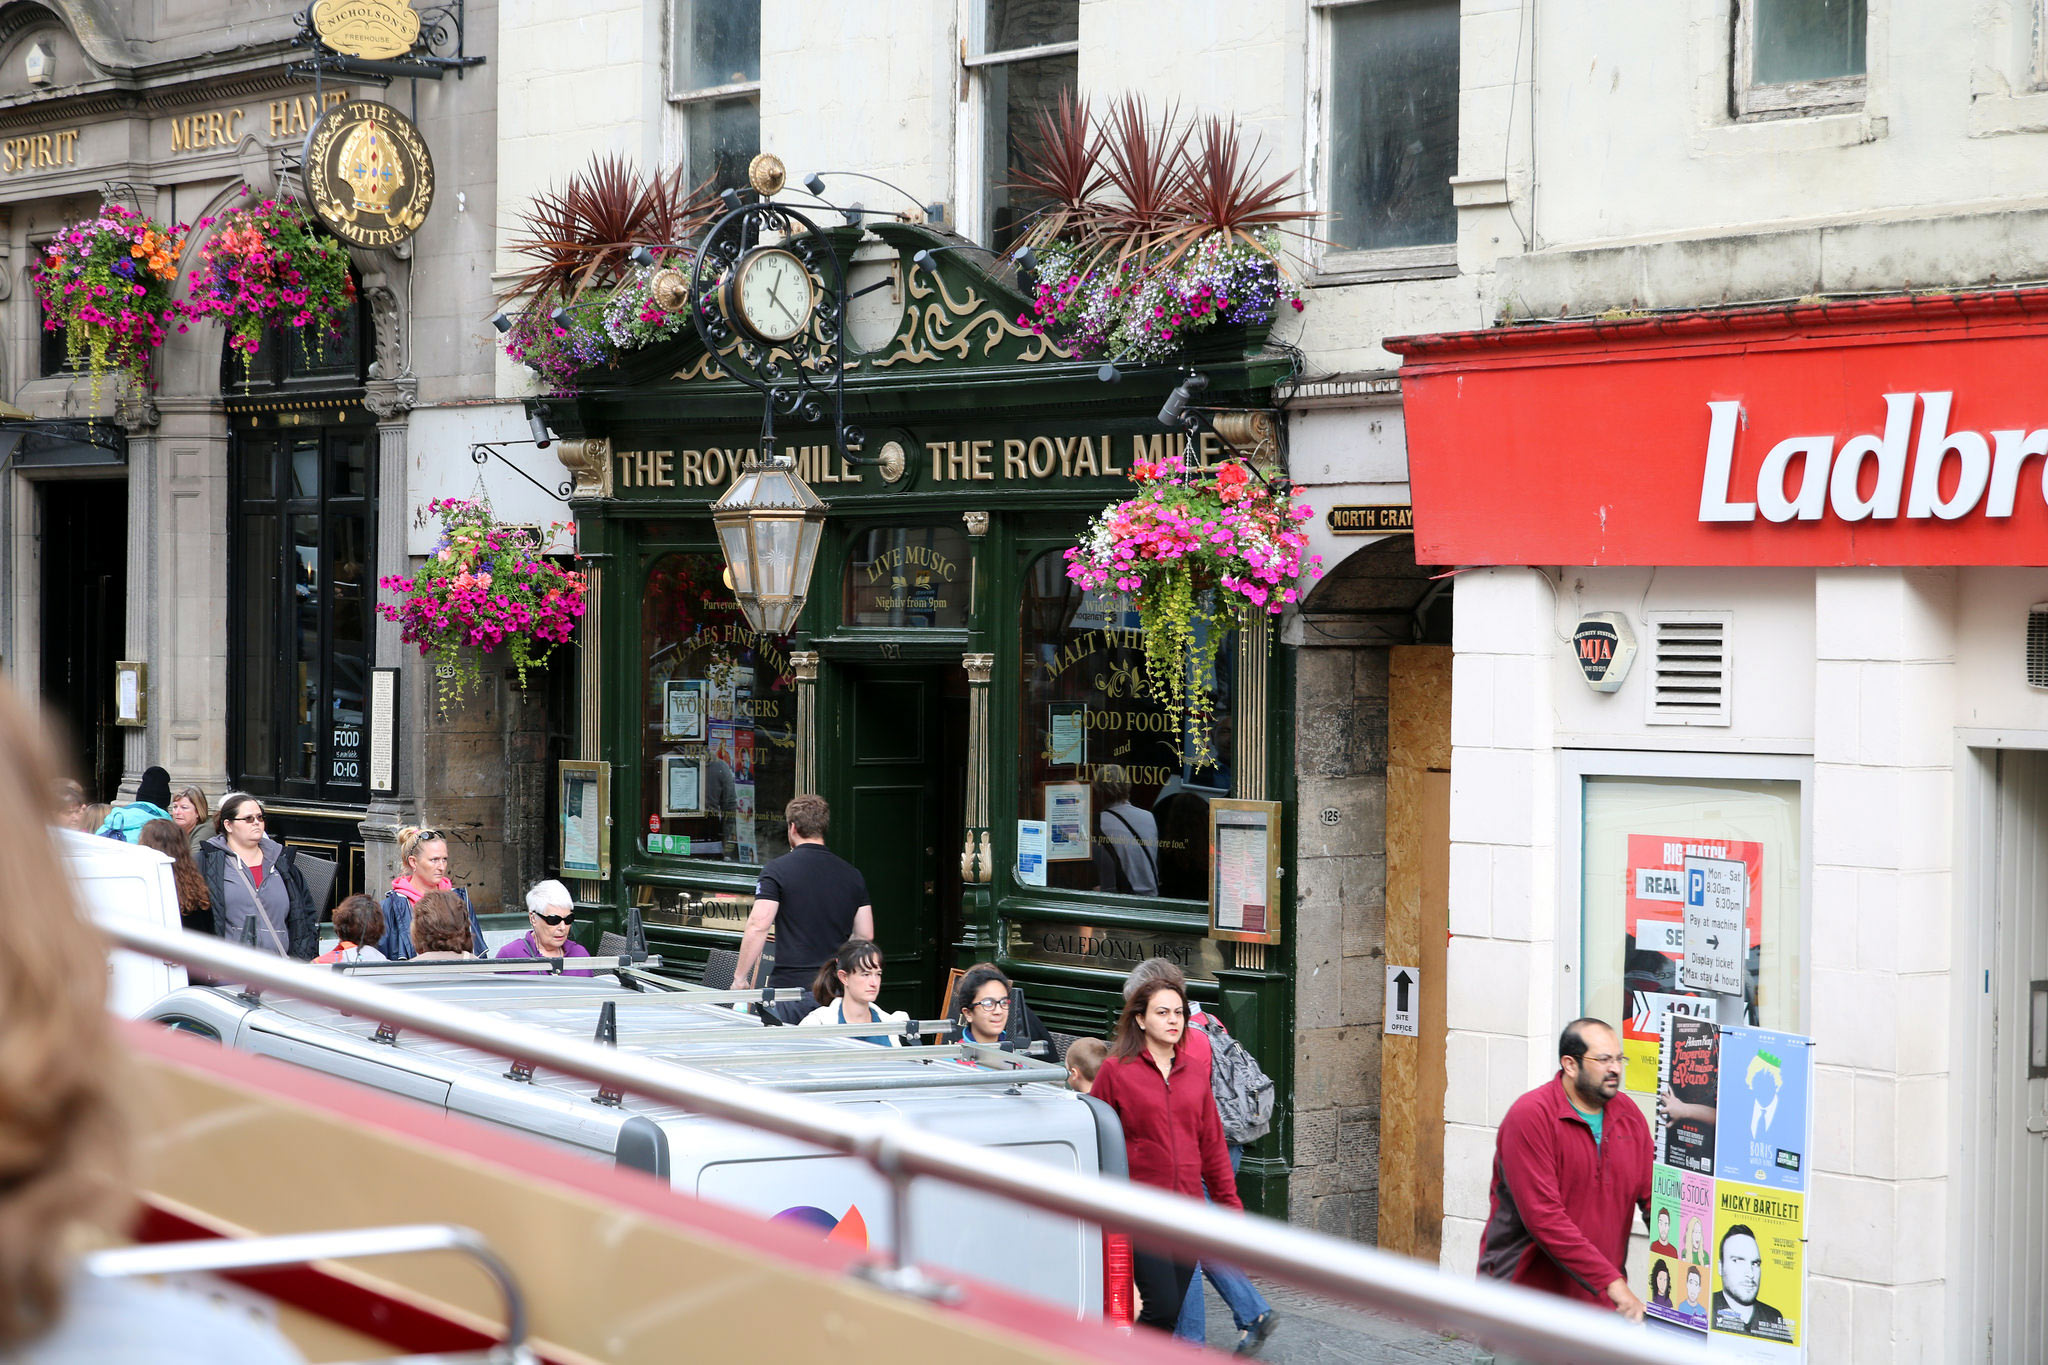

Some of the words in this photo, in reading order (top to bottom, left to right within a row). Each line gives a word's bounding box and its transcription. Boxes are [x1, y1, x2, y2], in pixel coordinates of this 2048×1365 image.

[327, 8, 408, 34] NICHOLSON'S
[344, 33, 390, 44] FREEHOUSE
[348, 103, 391, 123] THE
[3, 129, 79, 175] SPIRIT
[170, 109, 244, 153] MERC
[339, 222, 405, 247] MITRE
[617, 450, 675, 487] THE
[683, 447, 768, 487] ROY
[785, 444, 863, 483] MILE
[926, 440, 994, 482] THE
[1004, 435, 1123, 479] ROYAL
[1134, 432, 1221, 475] MILE
[1699, 391, 2048, 524] Ladbr
[1334, 510, 1375, 527] NORTH
[866, 548, 902, 585] LIVE
[905, 546, 957, 583] MUSIC
[704, 598, 740, 613] Purveyors
[875, 596, 905, 612] Nightly
[906, 595, 927, 608] from
[929, 596, 947, 611] 9pm
[688, 625, 718, 651] ALES
[724, 625, 756, 650] FINE
[758, 637, 798, 693] WINES
[1044, 630, 1097, 682] MALT
[1103, 627, 1147, 650] WHI
[1579, 638, 1611, 664] MJA
[1071, 709, 1122, 731] GOOD
[1126, 711, 1175, 733] FOOD
[333, 730, 359, 747] FOOD
[1113, 740, 1131, 757] and
[1074, 763, 1112, 784] LIVE
[1116, 764, 1171, 787] MUSIC
[1323, 810, 1338, 822] 125
[1663, 843, 1683, 865] BIG
[1708, 868, 1722, 880] Mon
[1729, 871, 1741, 882] Sat
[1645, 876, 1680, 895] REAL
[1692, 873, 1702, 902] P
[1706, 882, 1731, 895] 8.30am
[659, 898, 741, 922] CALEDONIA
[1715, 897, 1740, 912] 6.30pm
[1690, 914, 1700, 928] Pay
[1703, 917, 1709, 928] at
[1712, 919, 1737, 931] machine
[1666, 929, 1684, 945] SE
[1042, 933, 1145, 962] CALEDONIA
[1692, 953, 1713, 969] Display
[1715, 956, 1734, 970] ticket
[1686, 968, 1698, 980] Max
[1700, 971, 1713, 985] stay
[1715, 973, 1719, 983] 4
[1722, 974, 1740, 987] hours
[1391, 1023, 1412, 1032] OFFICE
[1395, 1013, 1409, 1022] SITE
[1750, 1141, 1773, 1160] BORIS
[1654, 1174, 1686, 1201] LAUGHING
[1687, 1184, 1709, 1207] STOCK
[1721, 1193, 1751, 1211] MICKY
[1753, 1198, 1799, 1220] BARTLETT
